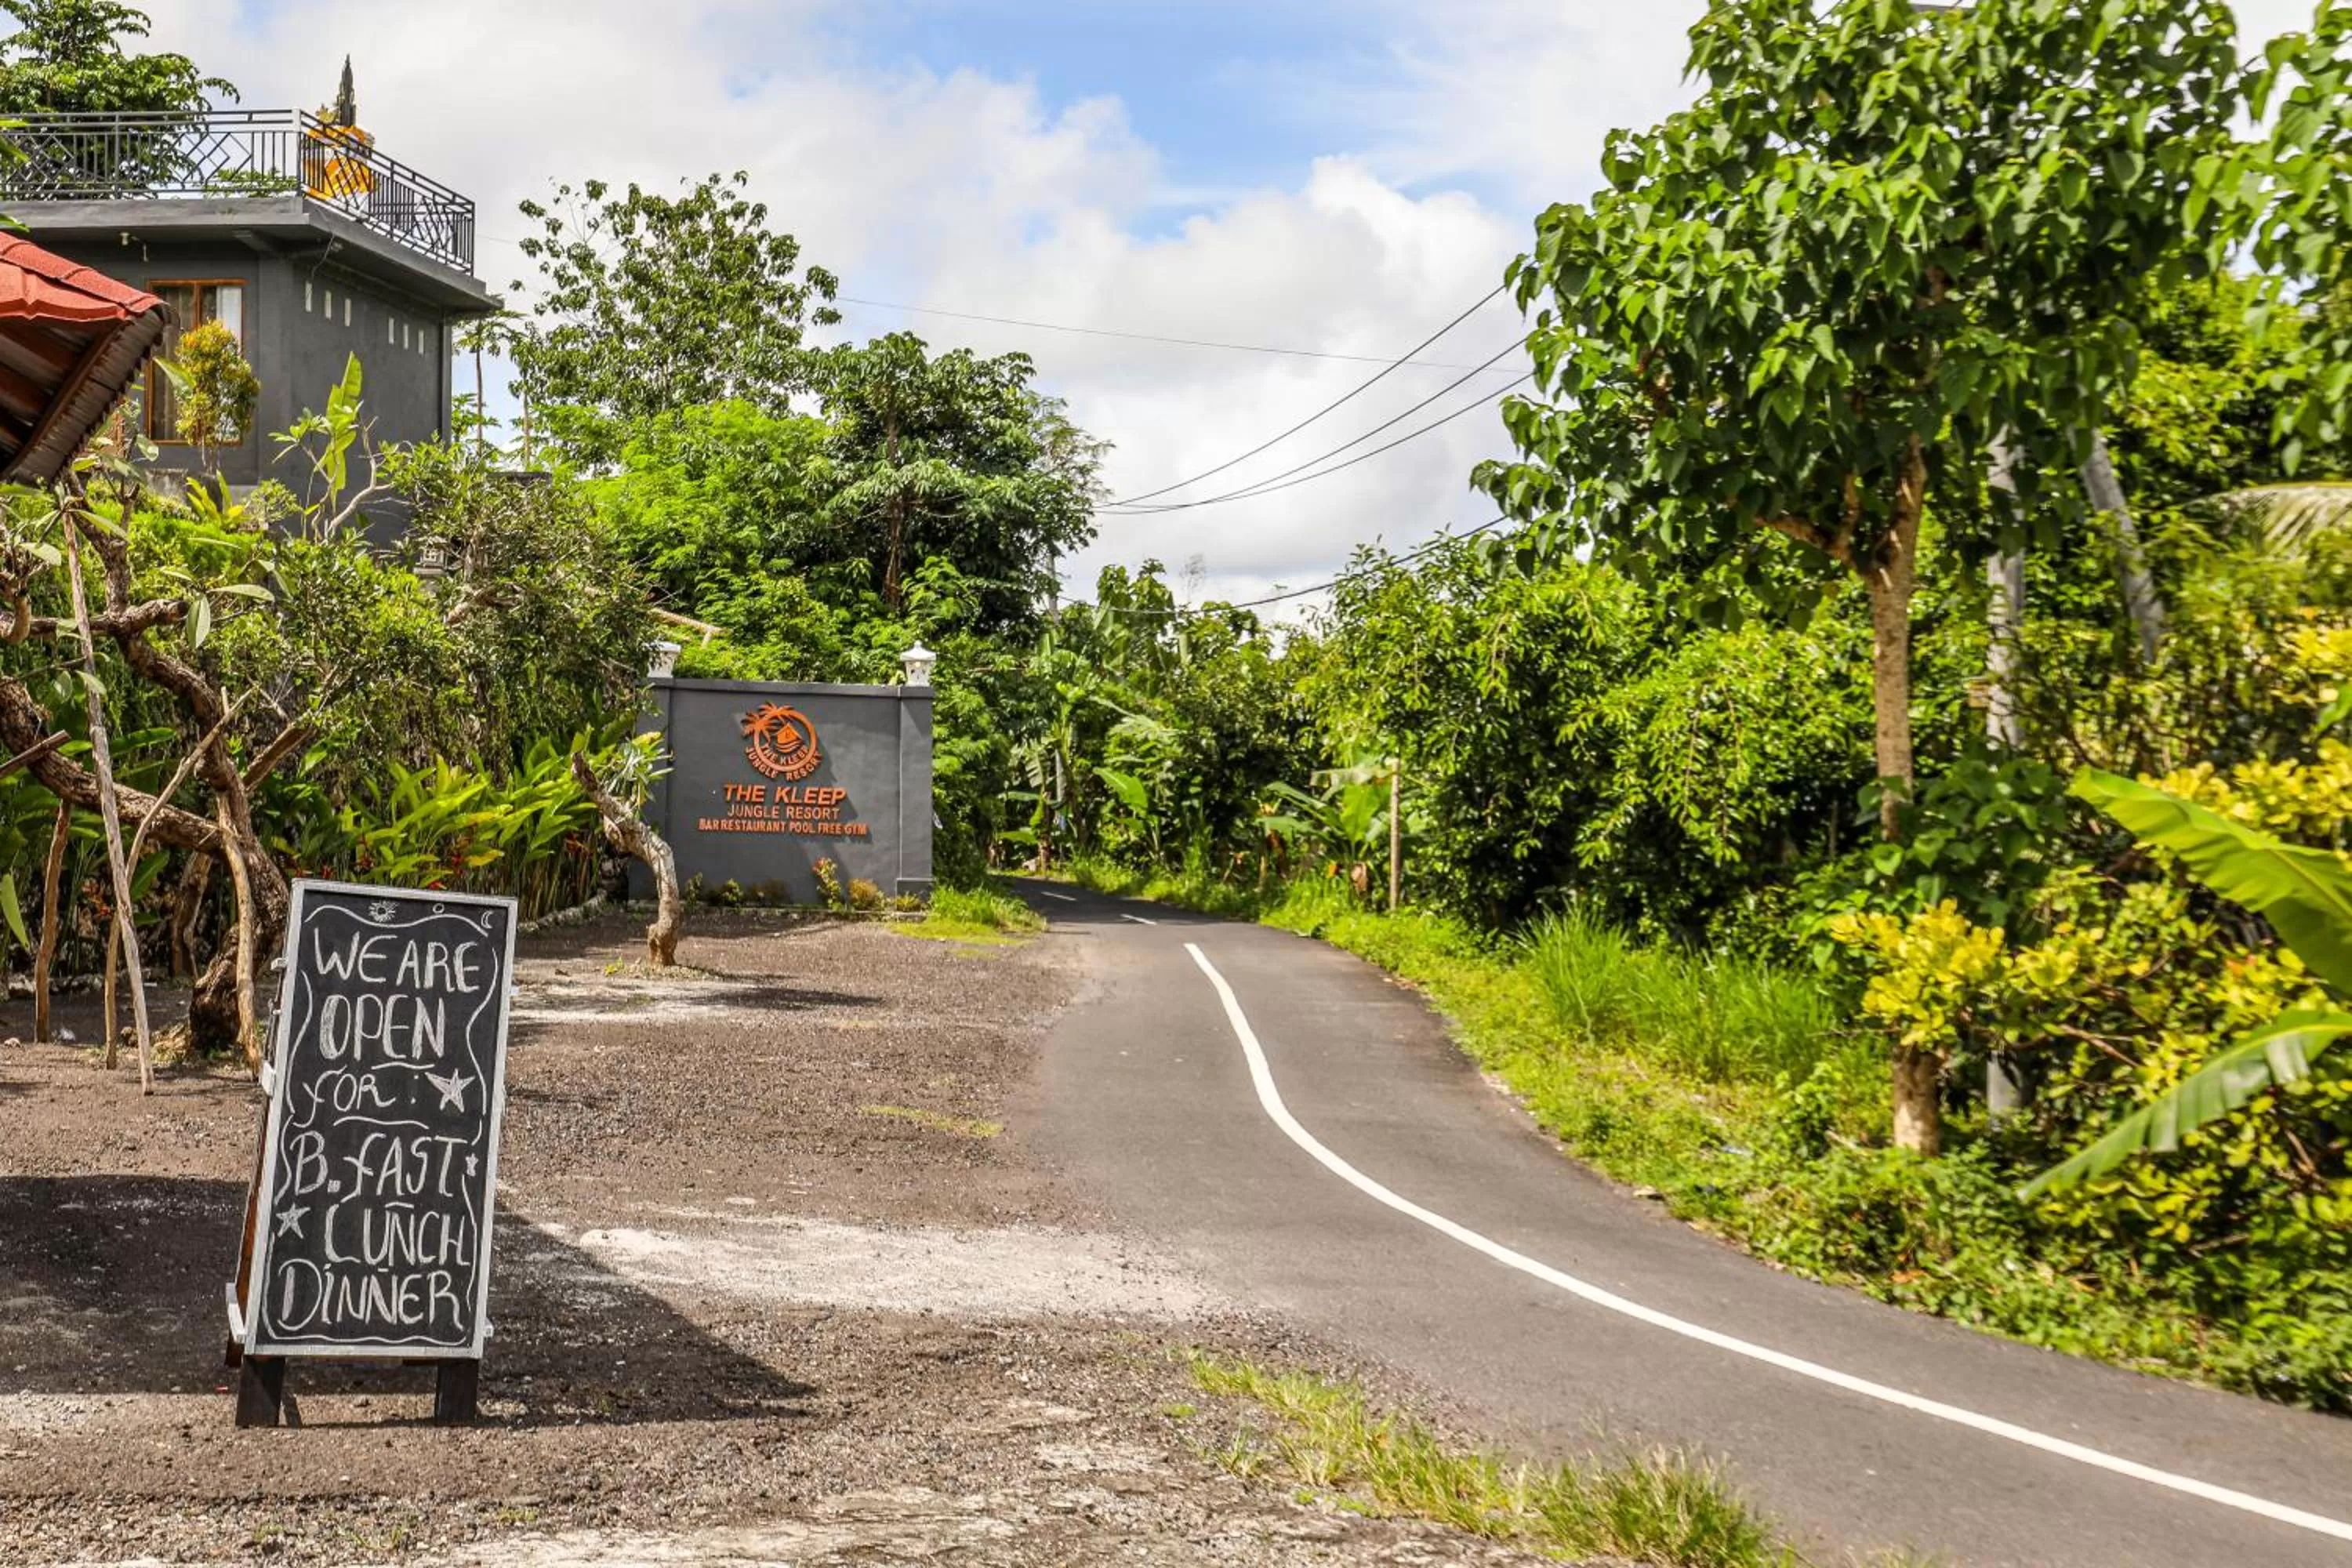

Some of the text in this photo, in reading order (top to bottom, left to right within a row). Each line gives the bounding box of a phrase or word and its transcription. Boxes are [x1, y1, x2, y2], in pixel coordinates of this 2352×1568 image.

[745, 746, 822, 781] JUNGLE RESORT
[724, 784, 847, 805] THE KLEEP
[727, 804, 840, 820] JUNGLE RESORT
[789, 820, 816, 833] POOL
[818, 822, 842, 835] FREE
[844, 822, 866, 835] GYM
[314, 927, 481, 993] WE ARE
[318, 993, 446, 1062] OPEN
[324, 1203, 470, 1268] LUNCH
